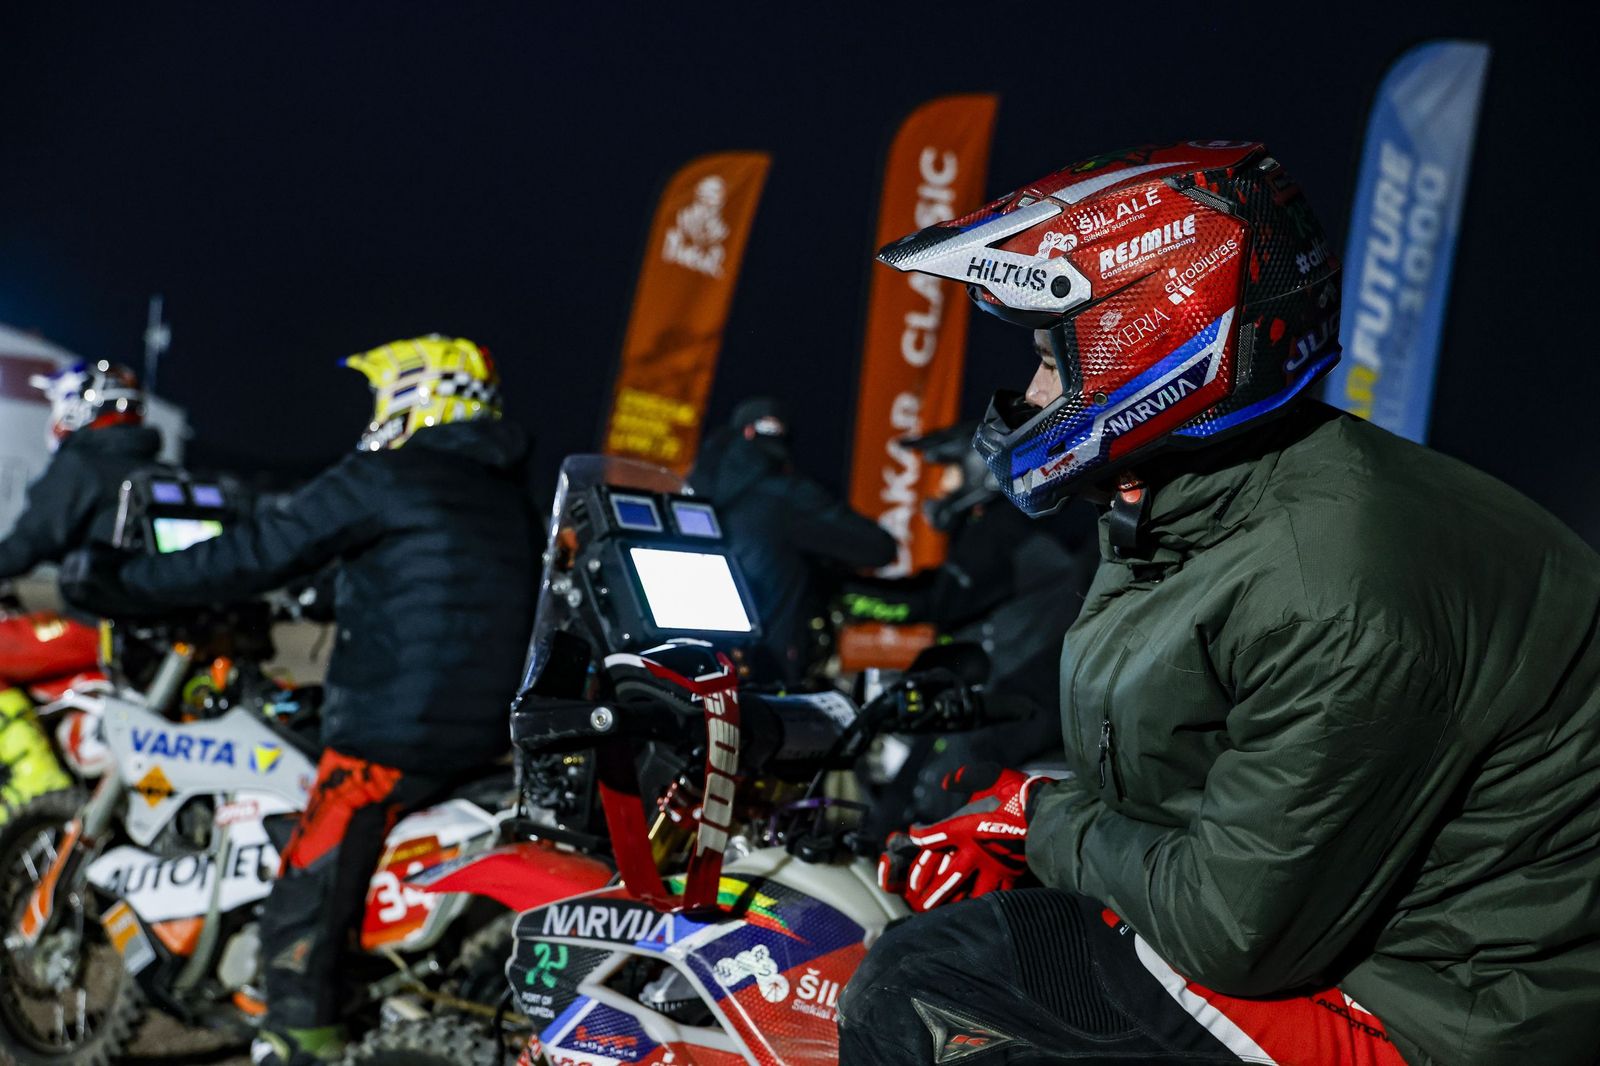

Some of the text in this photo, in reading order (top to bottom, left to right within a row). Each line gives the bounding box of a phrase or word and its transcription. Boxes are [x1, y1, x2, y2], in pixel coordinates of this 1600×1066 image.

[902, 146, 959, 368] CLASIC
[1099, 214, 1196, 273] RESMILE
[1101, 236, 1197, 280] Construction company
[1164, 238, 1238, 294] eurobiuras
[1351, 140, 1414, 371] FUTURE
[1108, 378, 1198, 436] NARVIJA
[131, 725, 236, 767] VARTA
[542, 904, 675, 945] NARVIJA
